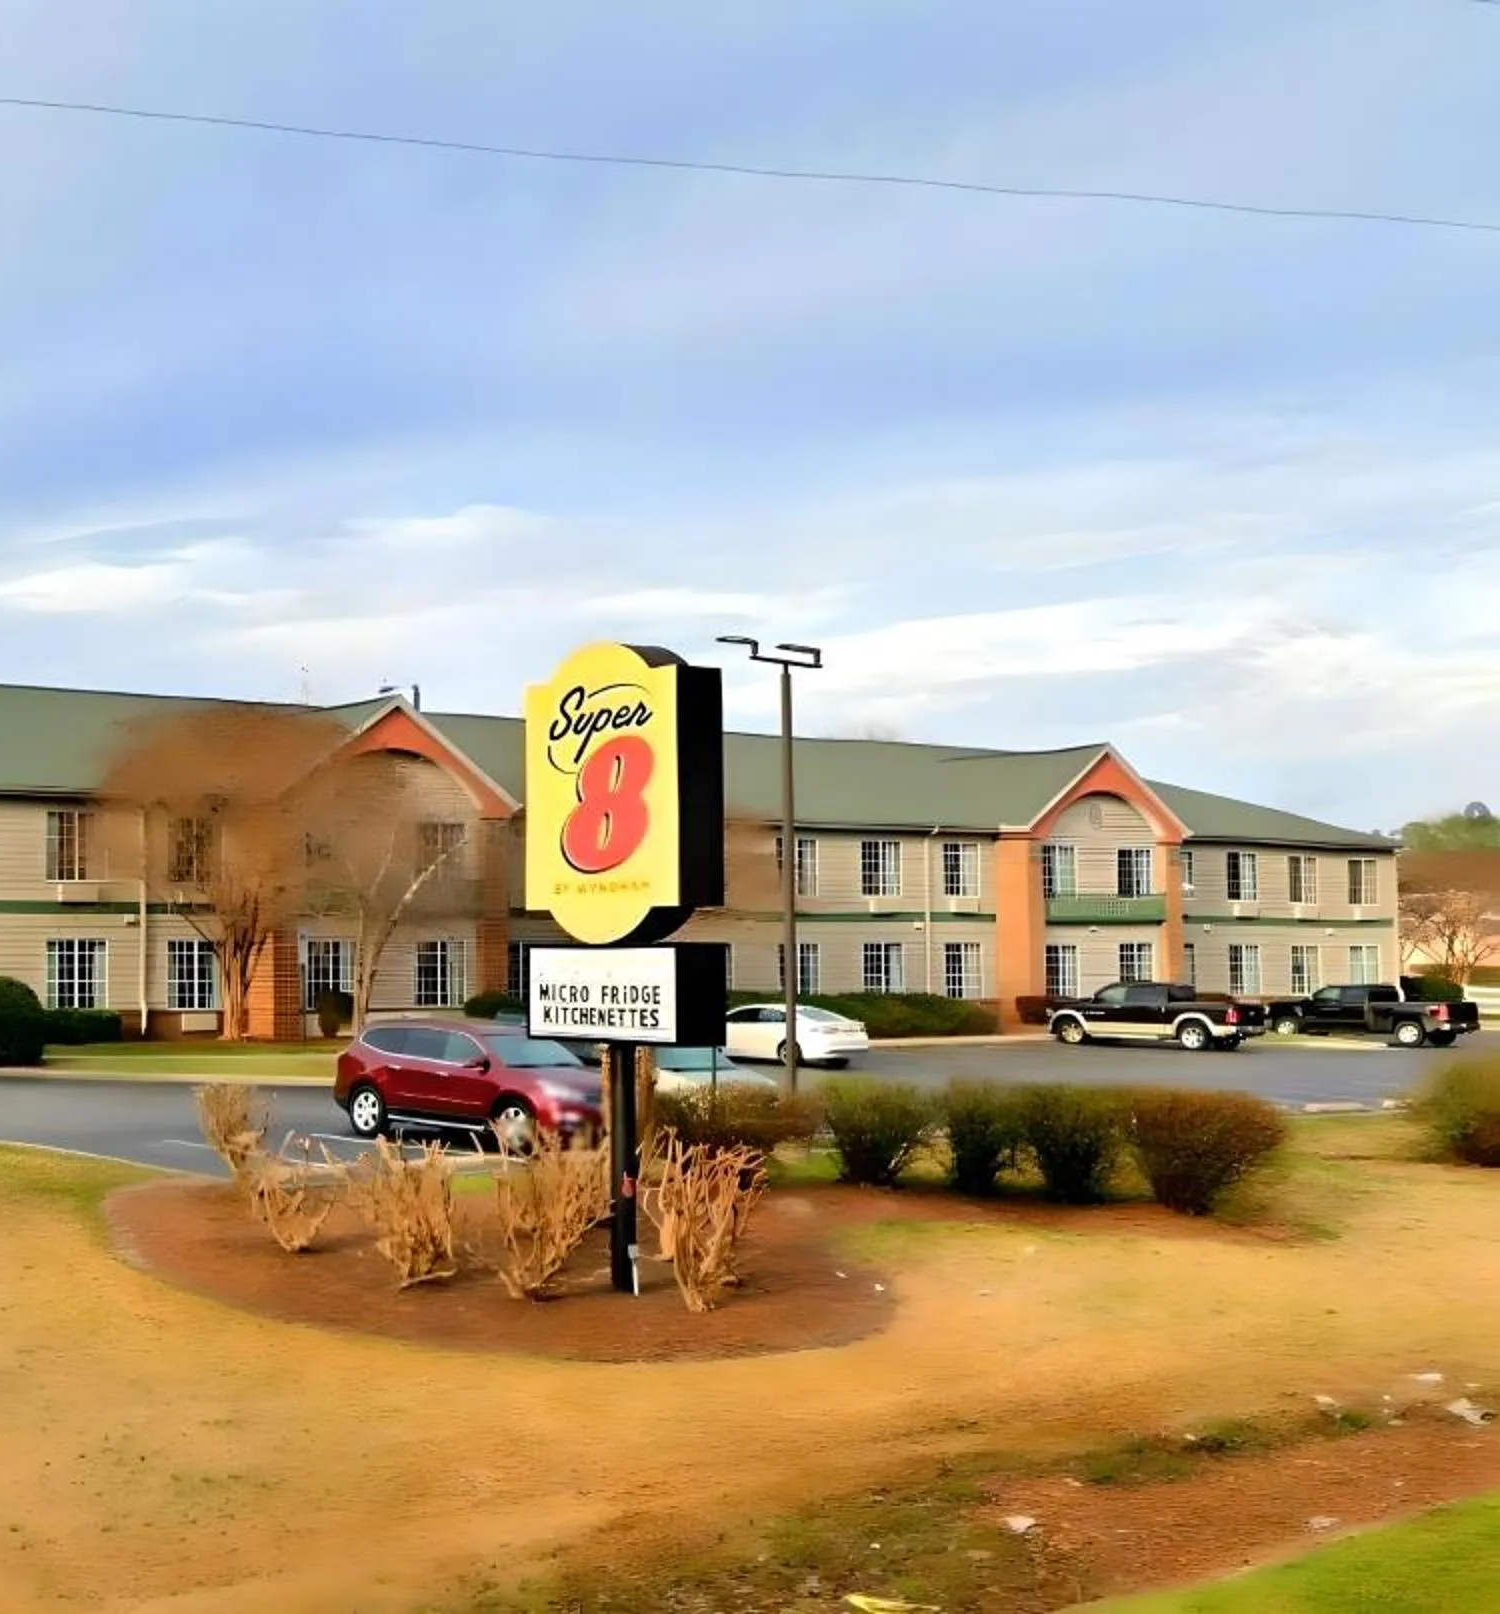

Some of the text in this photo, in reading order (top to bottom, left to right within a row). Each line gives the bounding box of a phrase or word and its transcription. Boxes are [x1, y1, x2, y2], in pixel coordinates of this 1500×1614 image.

[549, 685, 653, 764] Super
[559, 734, 655, 874] 8
[539, 983, 590, 1003] MICRO
[543, 1005, 660, 1028] KITCHENETTES
